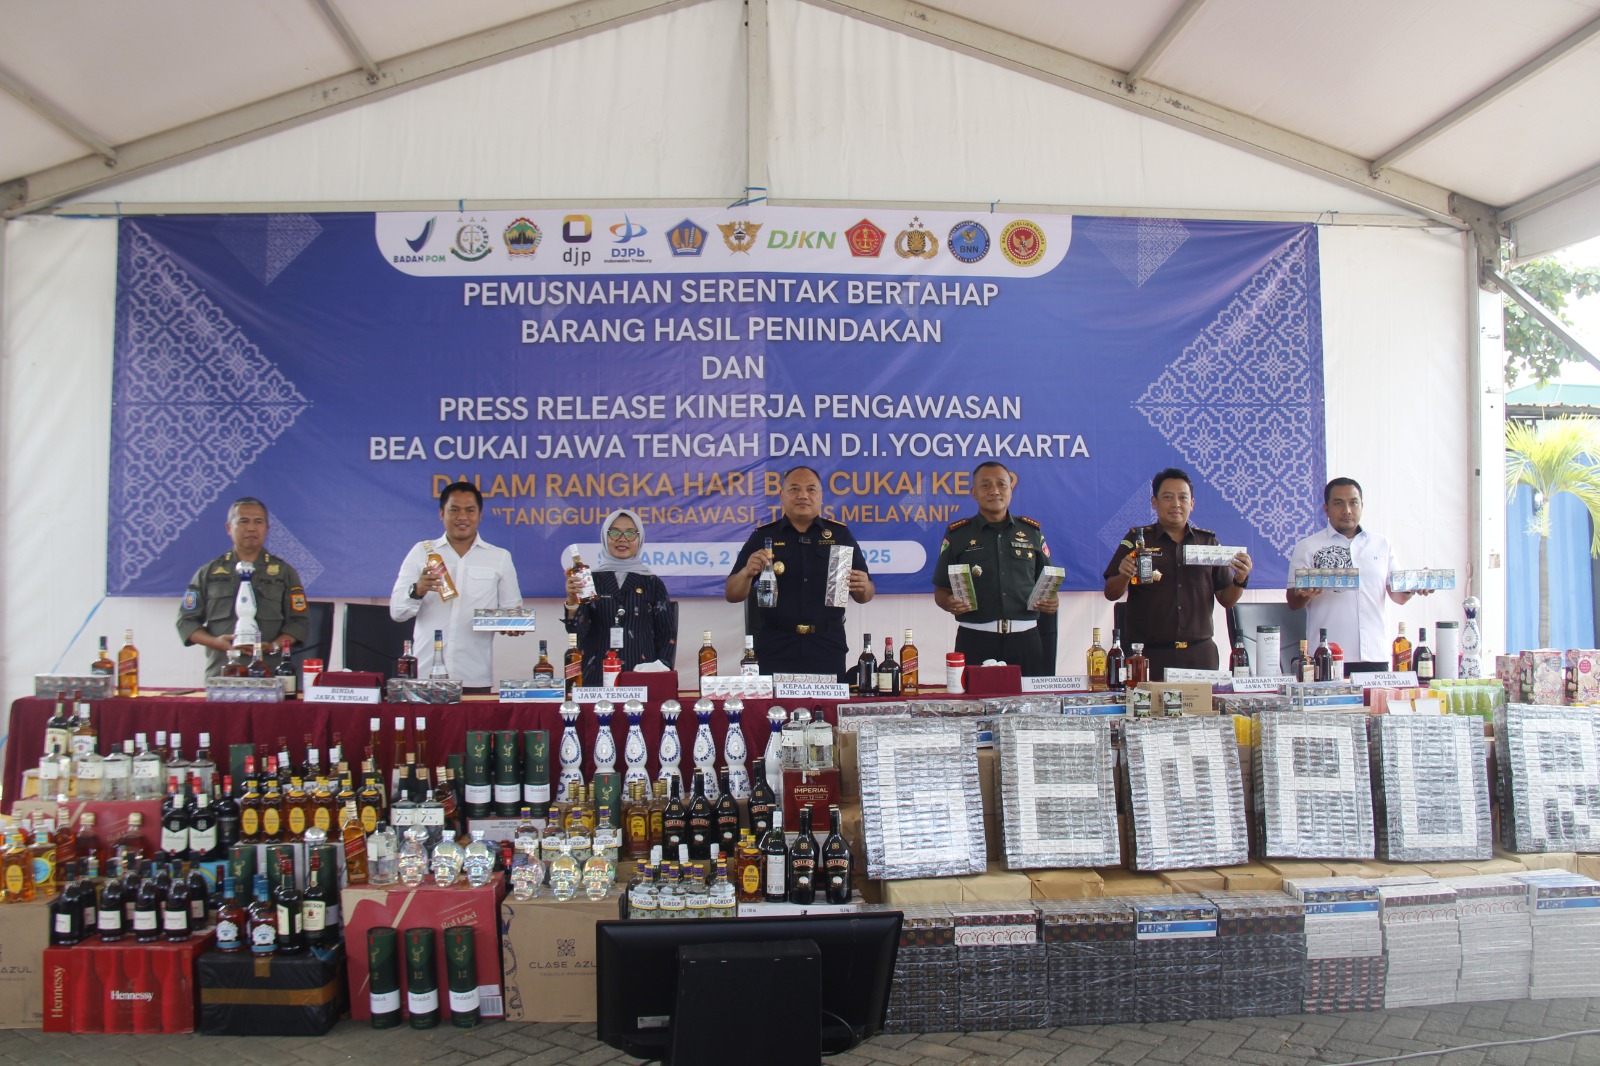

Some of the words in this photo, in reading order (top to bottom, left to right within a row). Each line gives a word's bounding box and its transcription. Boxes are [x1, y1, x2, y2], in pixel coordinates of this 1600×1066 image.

[426, 254, 446, 262] POM
[562, 248, 591, 266] djp
[611, 248, 645, 258] DJPb
[464, 279, 672, 306] PEMUSNAHAN
[680, 278, 840, 305] SERENTAK
[847, 280, 999, 306] BERTAHAP
[521, 318, 645, 344] BARANG
[654, 317, 741, 342] HASIL
[748, 317, 941, 343] PENINDAKAN
[702, 355, 764, 380] DAN
[440, 396, 529, 421] PRESS
[537, 394, 666, 420] RELEASE
[675, 393, 807, 419] KINERJA
[814, 394, 1021, 420] PENGAWASAN
[369, 436, 427, 460] BEA
[433, 435, 527, 460] CUKAI
[535, 434, 626, 459] JAWA
[632, 432, 759, 458] TENGAH
[769, 432, 831, 457] DAN
[841, 432, 1090, 458] D.I.YOGYAKARTA
[545, 472, 676, 498] RANGKA
[683, 471, 754, 496] HARI
[829, 470, 923, 496] CUKAI
[618, 504, 761, 526] ENGAWASI,
[720, 551, 730, 565] 2
[861, 549, 891, 564] 25
[501, 690, 527, 698] JUST
[1305, 904, 1336, 913] JUST
[1539, 899, 1566, 908] JUST
[441, 919, 457, 930] Red
[457, 911, 477, 924] Label
[1140, 923, 1171, 934] JUST
[0, 966, 32, 974] AZUL
[574, 960, 596, 968] AZU
[51, 966, 66, 1018] Hennessy
[110, 990, 154, 1002] Hennessy
